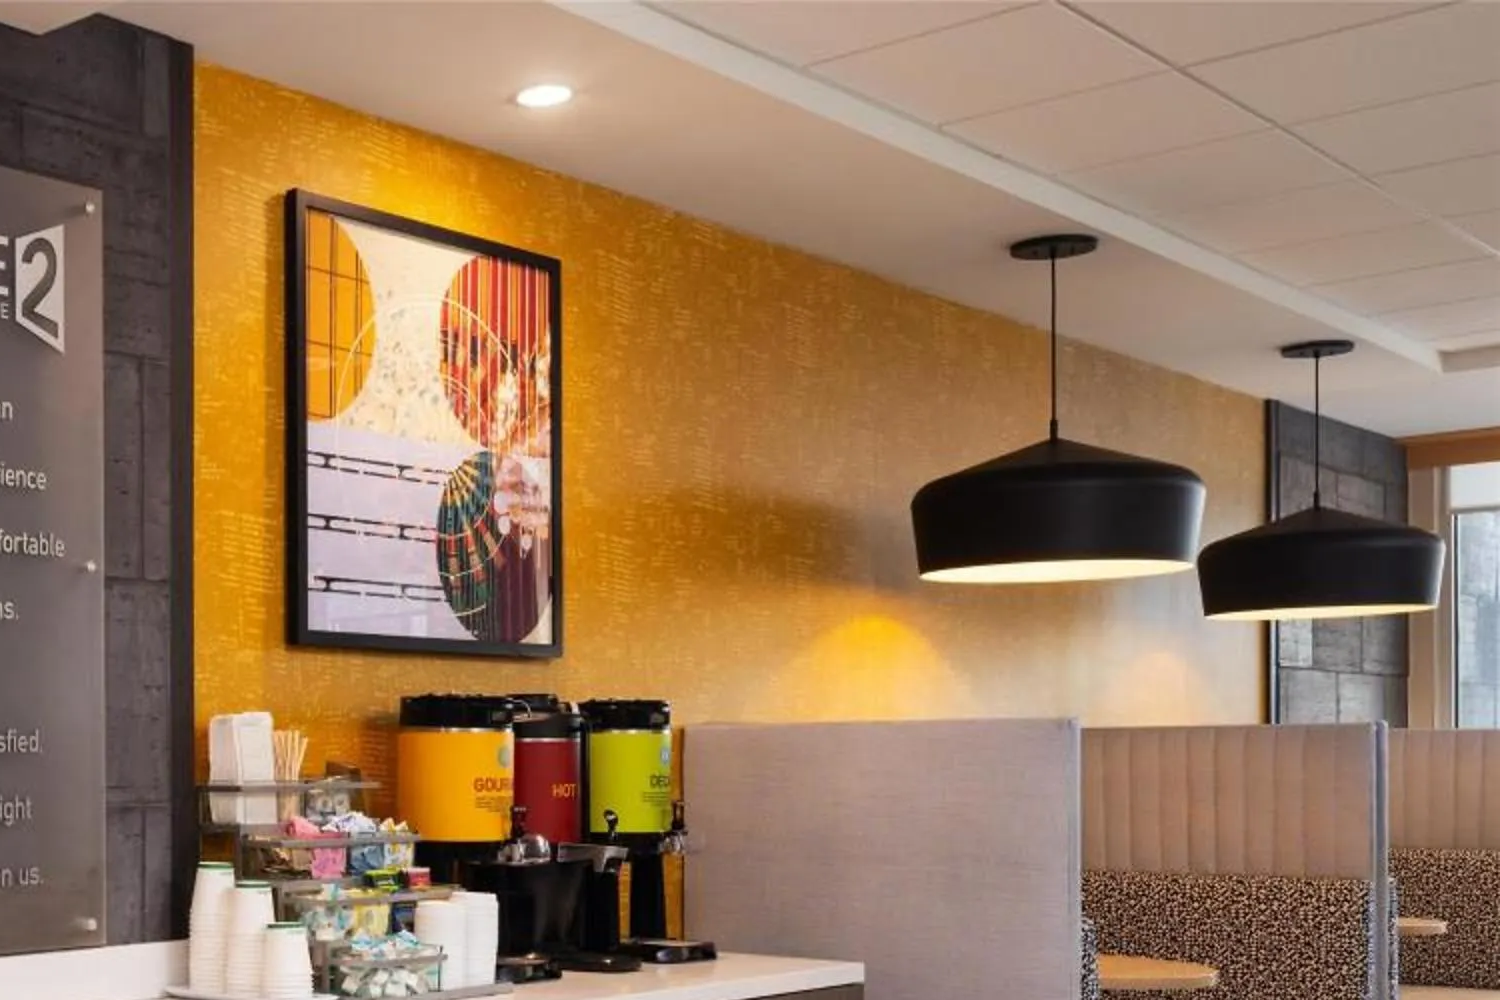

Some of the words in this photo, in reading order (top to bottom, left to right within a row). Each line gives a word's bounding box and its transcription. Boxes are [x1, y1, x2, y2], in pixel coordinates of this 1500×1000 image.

[473, 776, 514, 793] GOUR
[649, 774, 670, 789] DEC
[551, 783, 577, 800] HOT
[19, 865, 45, 886] us.
